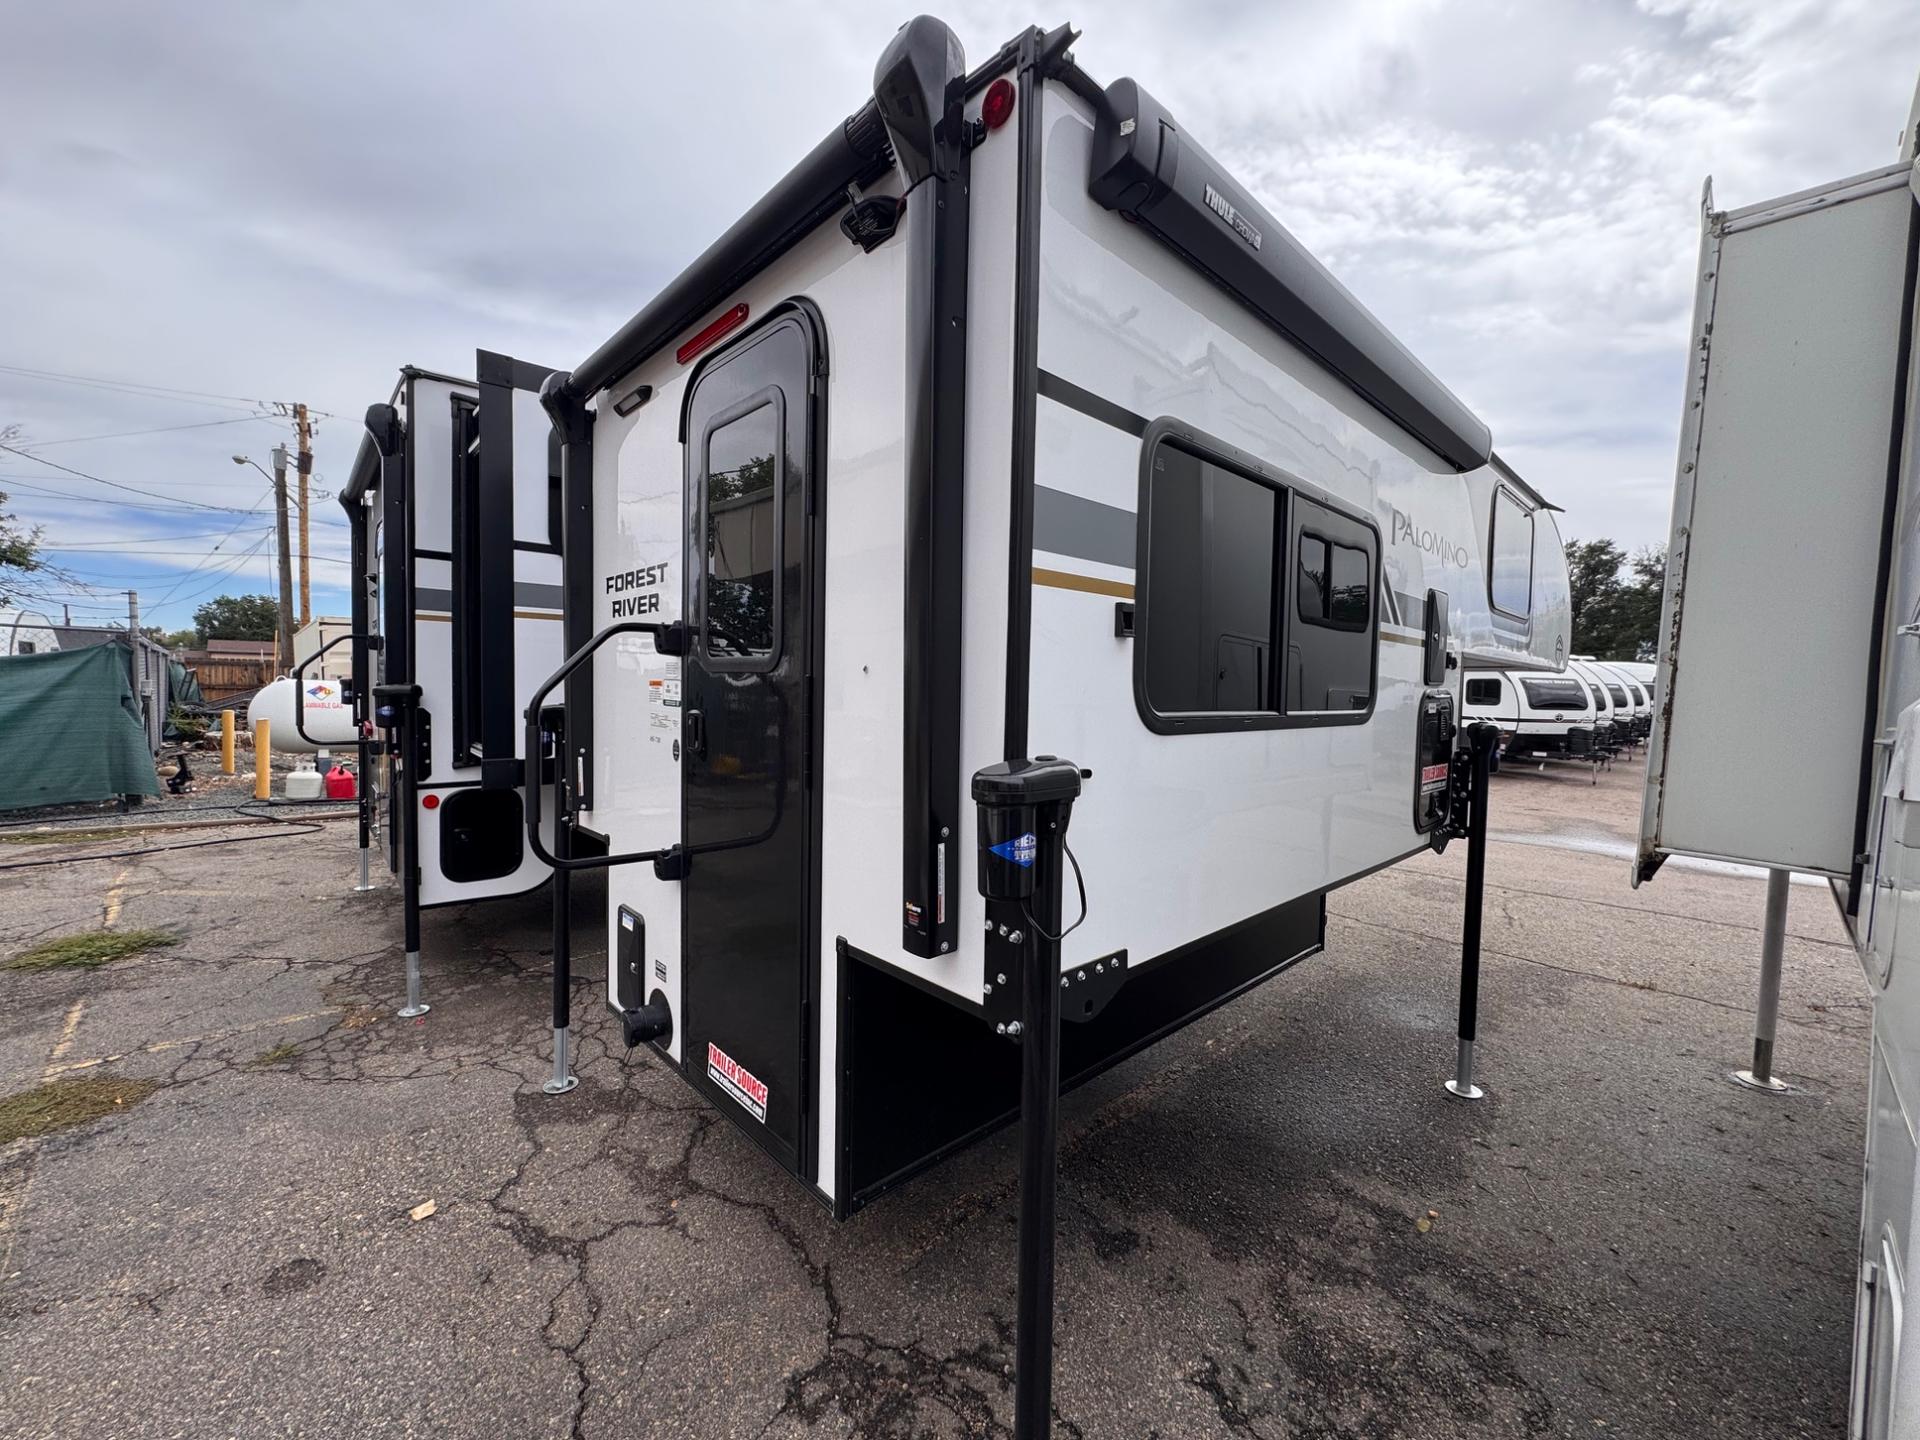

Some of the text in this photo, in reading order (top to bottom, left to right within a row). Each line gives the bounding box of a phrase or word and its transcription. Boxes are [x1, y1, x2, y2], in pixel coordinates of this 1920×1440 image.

[1205, 183, 1236, 225] THULE
[1391, 507, 1469, 569] PALOMINO
[606, 562, 668, 595] FOREST
[612, 593, 660, 618] RIVER
[709, 1045, 737, 1080] TRAILER
[737, 1066, 767, 1105] SOURCE
